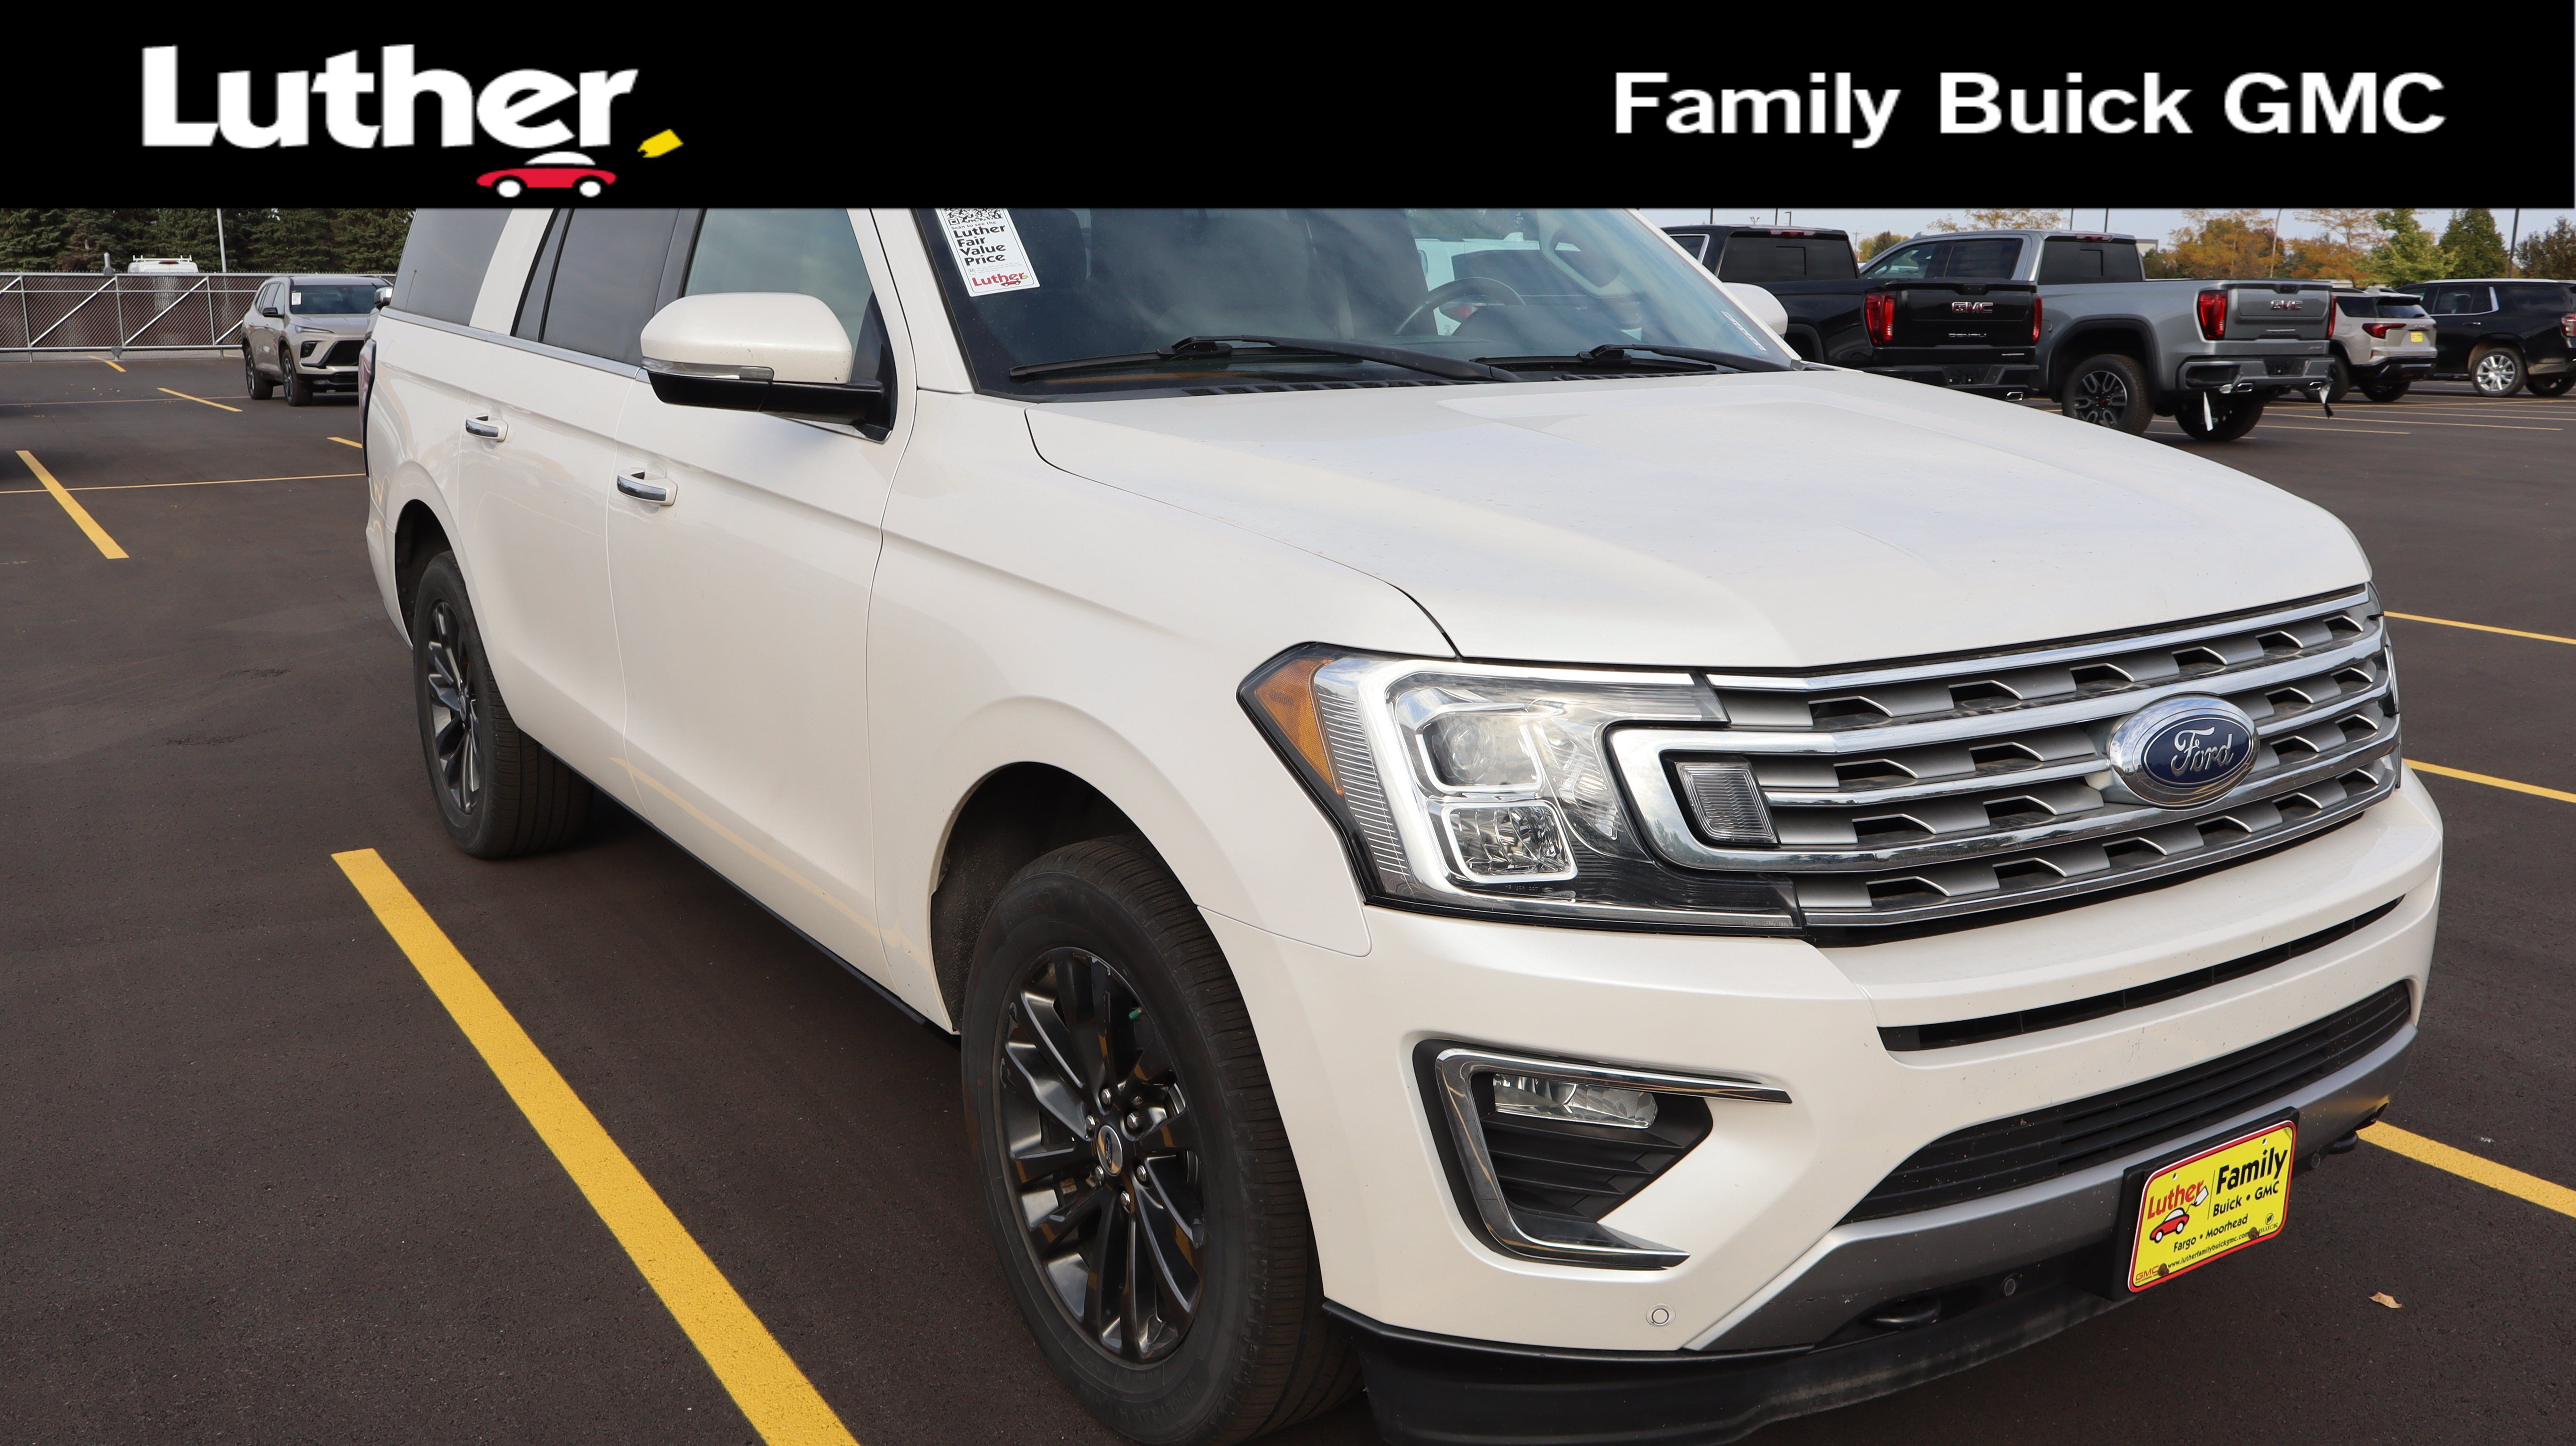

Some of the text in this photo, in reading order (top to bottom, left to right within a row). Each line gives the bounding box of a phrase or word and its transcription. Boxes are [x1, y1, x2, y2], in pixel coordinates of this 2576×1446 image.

[953, 225, 1005, 238] Luther
[957, 236, 985, 247] Fair
[959, 245, 1006, 256] Value
[964, 254, 1006, 266] Price
[972, 272, 1024, 286] Luther
[1952, 301, 1994, 313] GMC
[2171, 726, 2234, 777] Ford
[2148, 1147, 2288, 1220] Luther Family
[2213, 1181, 2279, 1217] Buick GMC
[2174, 1213, 2248, 1253] Fargo Moorhead
[2258, 1223, 2279, 1233] BUICK
[2136, 1265, 2159, 1281] GMC
